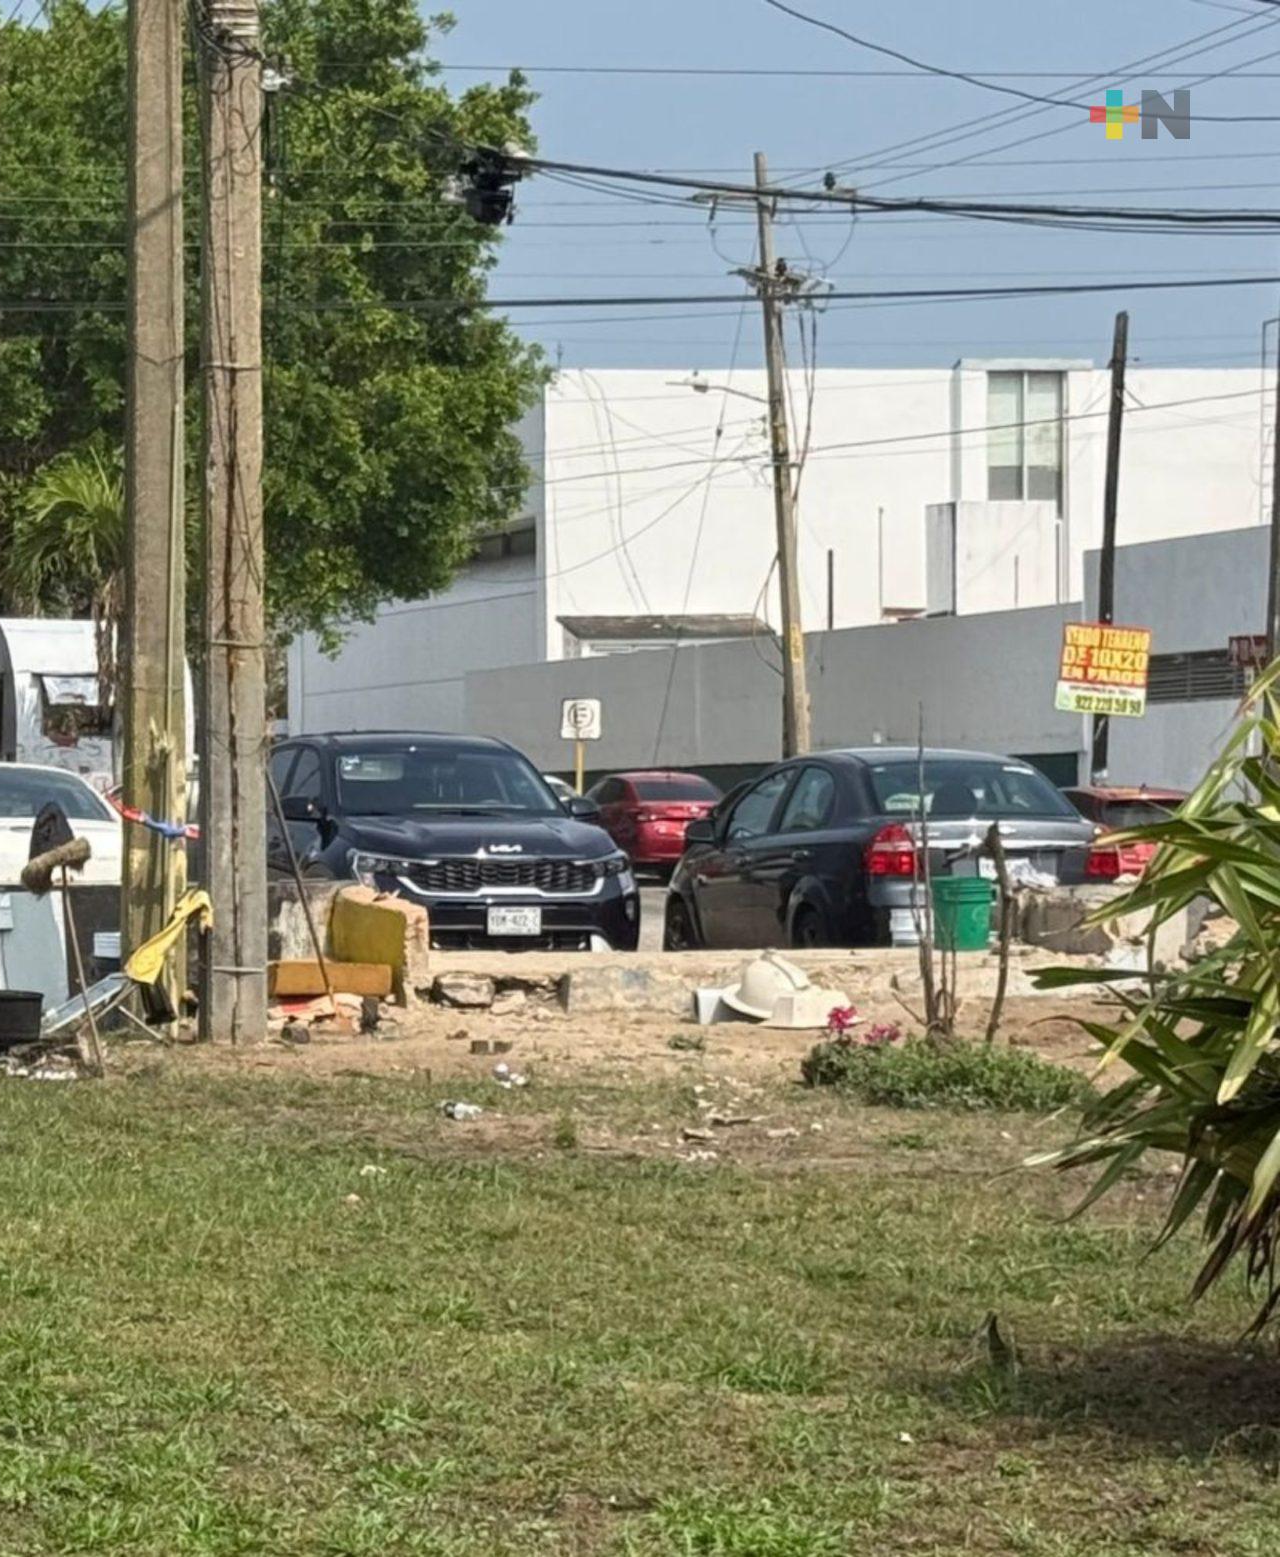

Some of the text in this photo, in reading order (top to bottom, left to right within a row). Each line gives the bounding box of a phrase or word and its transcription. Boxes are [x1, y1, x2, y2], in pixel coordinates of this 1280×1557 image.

[1066, 626, 1150, 651] VENDO TERRENO
[1063, 646, 1149, 672] DE 10X20
[1062, 665, 1084, 680] EN
